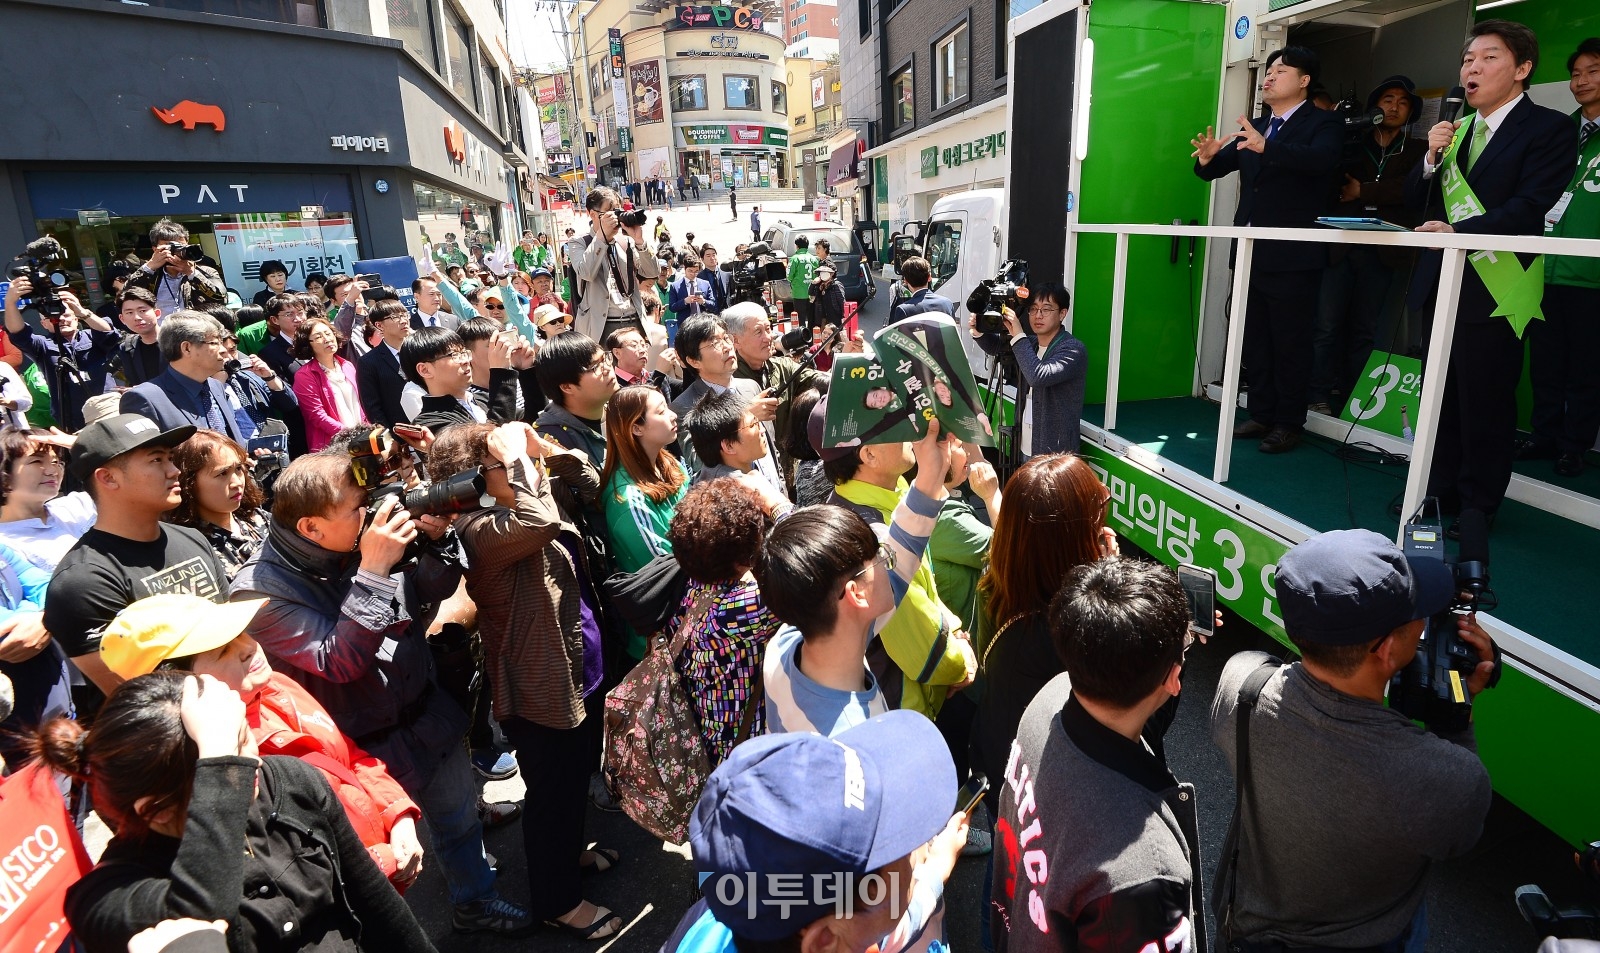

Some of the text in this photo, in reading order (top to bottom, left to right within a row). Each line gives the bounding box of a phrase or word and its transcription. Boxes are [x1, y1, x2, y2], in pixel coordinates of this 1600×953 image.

[331, 134, 389, 152] 피에이티
[241, 254, 346, 283] 특기획전
[806, 263, 817, 283] 3
[851, 366, 866, 379] 3
[1349, 363, 1401, 420] 3
[922, 406, 937, 421] 3
[1089, 462, 1200, 565] 민의당
[1213, 528, 1246, 601] 3
[151, 562, 205, 593] MIZUNO
